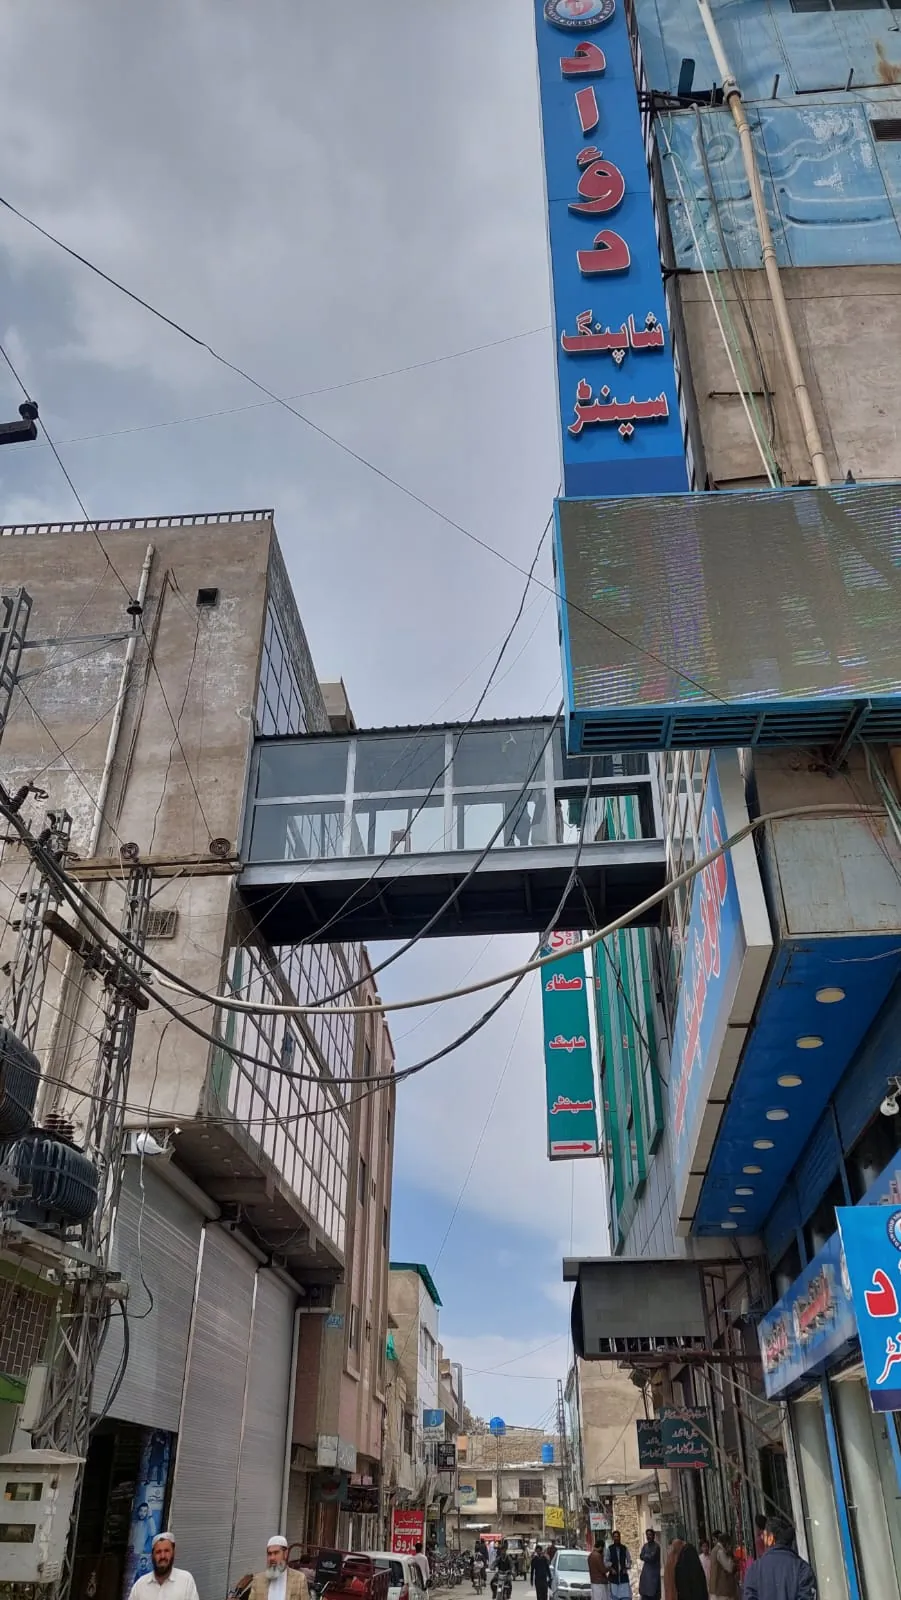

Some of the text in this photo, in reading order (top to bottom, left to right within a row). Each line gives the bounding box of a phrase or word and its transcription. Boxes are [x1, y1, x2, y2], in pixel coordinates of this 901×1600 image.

[561, 309, 664, 364] شاپنگ
[568, 378, 669, 436] سینٹر
[549, 1034, 587, 1053] شاپنگ
[550, 1095, 593, 1114] سینٹر
